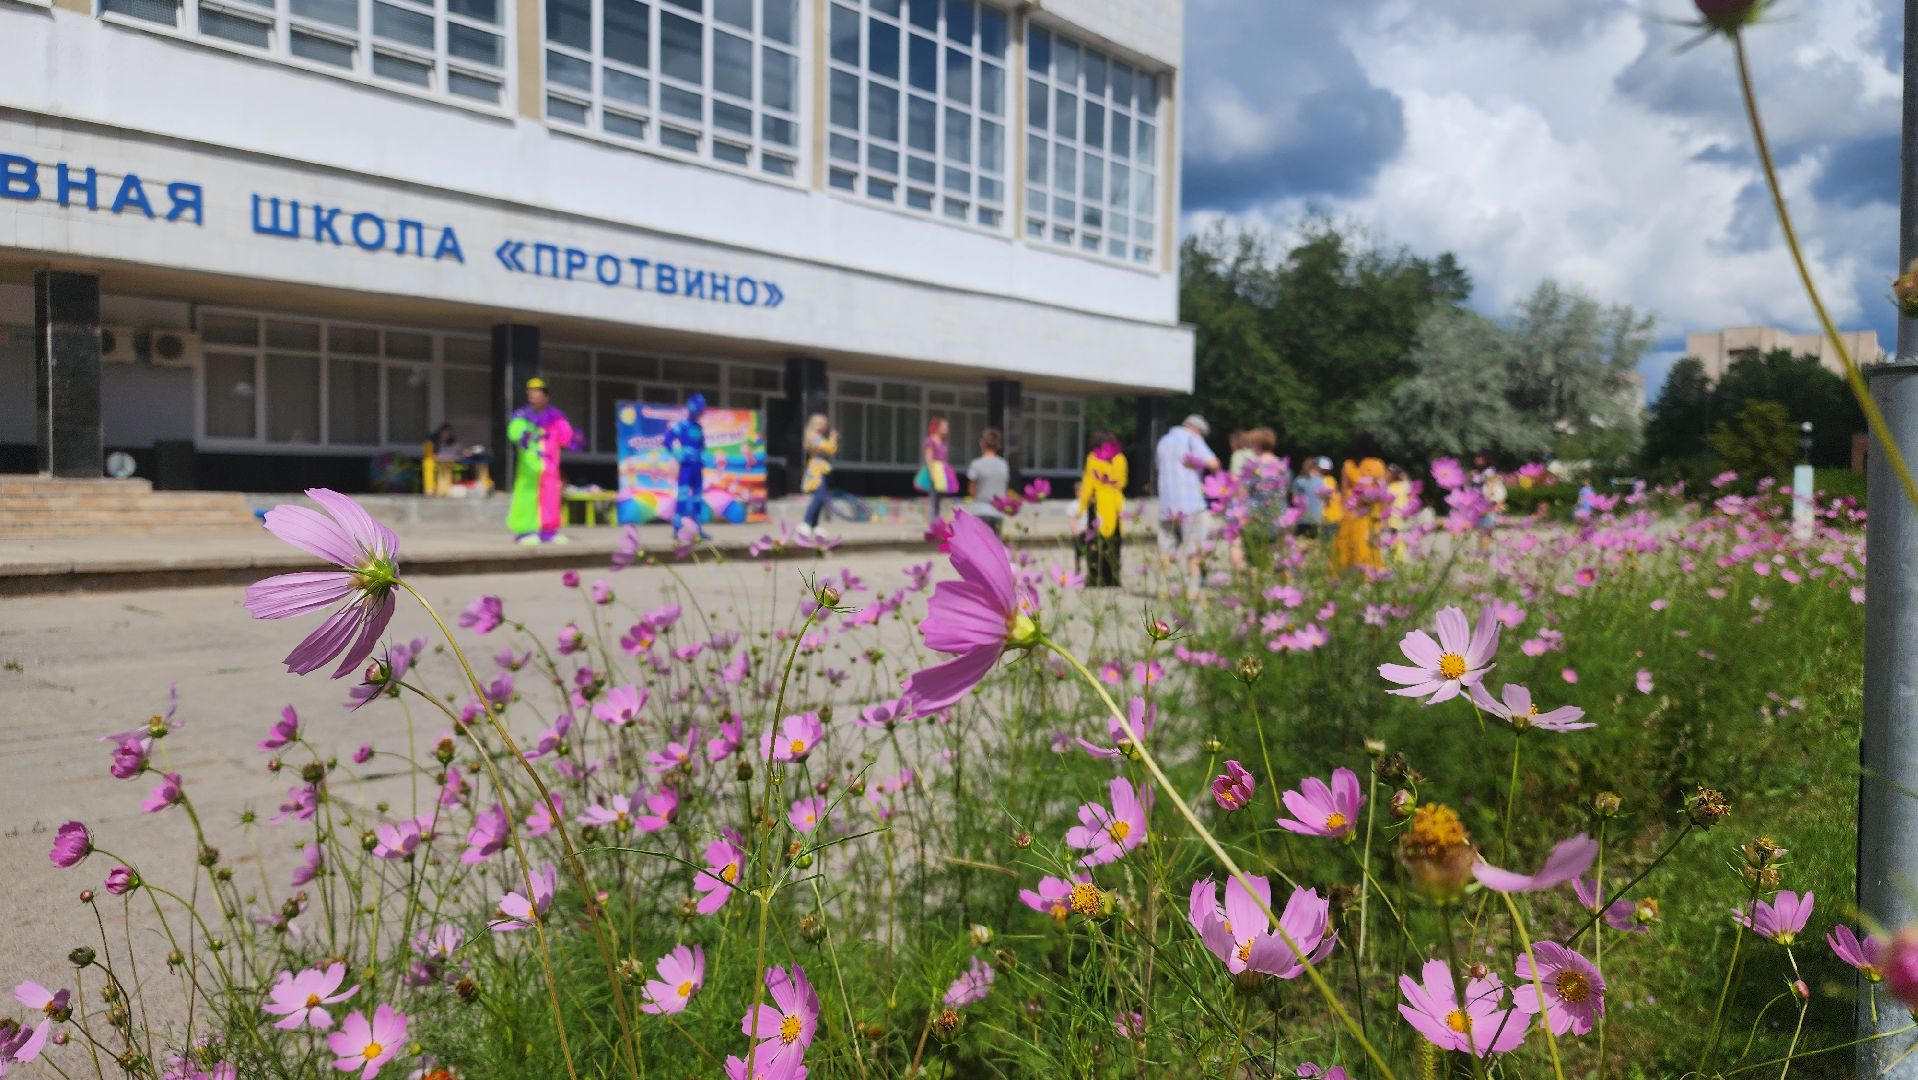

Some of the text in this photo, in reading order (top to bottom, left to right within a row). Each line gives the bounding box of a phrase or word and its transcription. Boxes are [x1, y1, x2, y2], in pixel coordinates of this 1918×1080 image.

[0, 153, 785, 308] ВНАЯ ШКОЛА «ПРОТВИНО»
